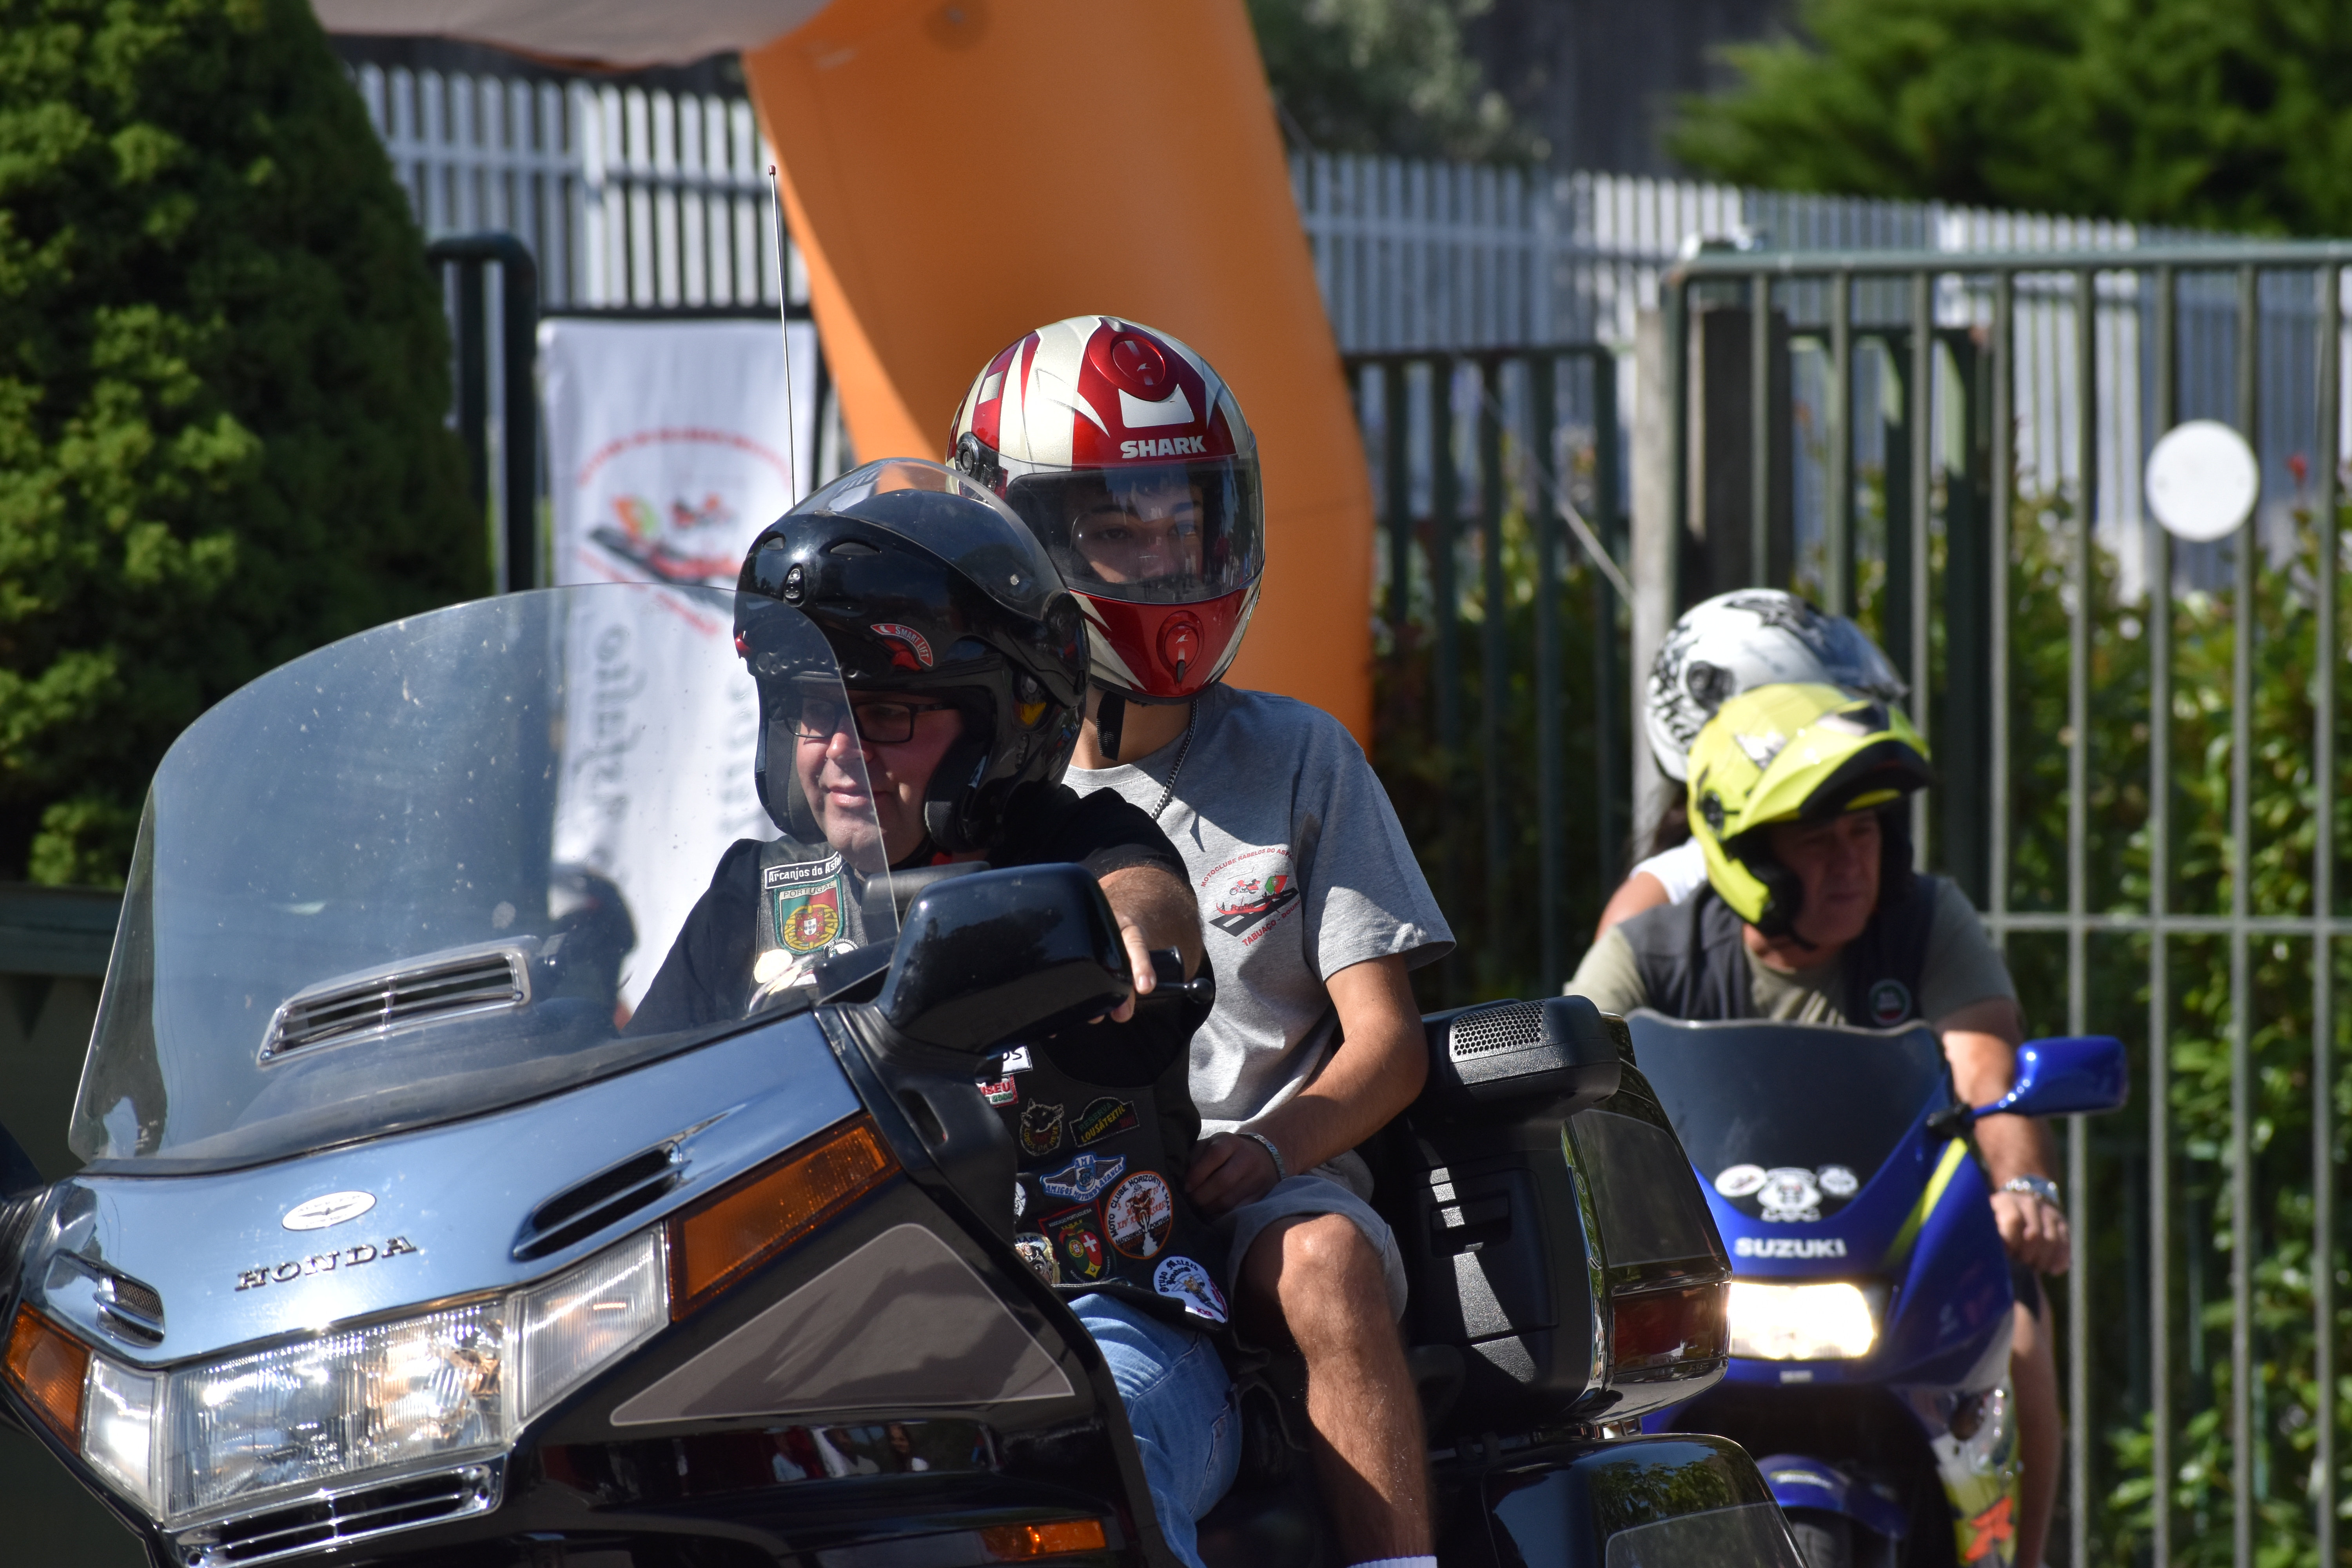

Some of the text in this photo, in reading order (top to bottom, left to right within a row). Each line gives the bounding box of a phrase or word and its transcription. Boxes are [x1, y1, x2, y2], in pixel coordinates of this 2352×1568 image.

[1120, 435, 1207, 459] SHARK
[895, 626, 929, 658] SMART LIFT
[769, 854, 842, 883] Arcanjos do Asfal
[1201, 858, 1237, 887] MOTOCLUBE
[1238, 848, 1265, 861] RABELOS
[1276, 848, 1294, 860] ASFA
[783, 882, 834, 898] PORTUGAL
[1241, 920, 1277, 947] TABUAÇO
[1281, 899, 1301, 919] DOURO
[978, 1082, 1011, 1095] ISEU
[1078, 1102, 1113, 1132] RESERVA
[1024, 1128, 1036, 1149] LOBOS
[1075, 1155, 1094, 1168] AMA
[1045, 1164, 1123, 1200] AMIGOS MOTARDS AVANCA
[1128, 1174, 1161, 1187] HORIZONTE
[1111, 1185, 1129, 1209] CLUBE
[1066, 1208, 1093, 1221] PORTUGUESA
[1109, 1213, 1119, 1238] MOTO
[1115, 1228, 1144, 1245] MATOSINHOS
[1149, 1213, 1171, 1230] PORTUGAL
[1733, 1236, 1848, 1259] SUZUKI
[234, 1235, 417, 1292] HONDA
[1158, 1259, 1198, 1292] Grupo Motard
